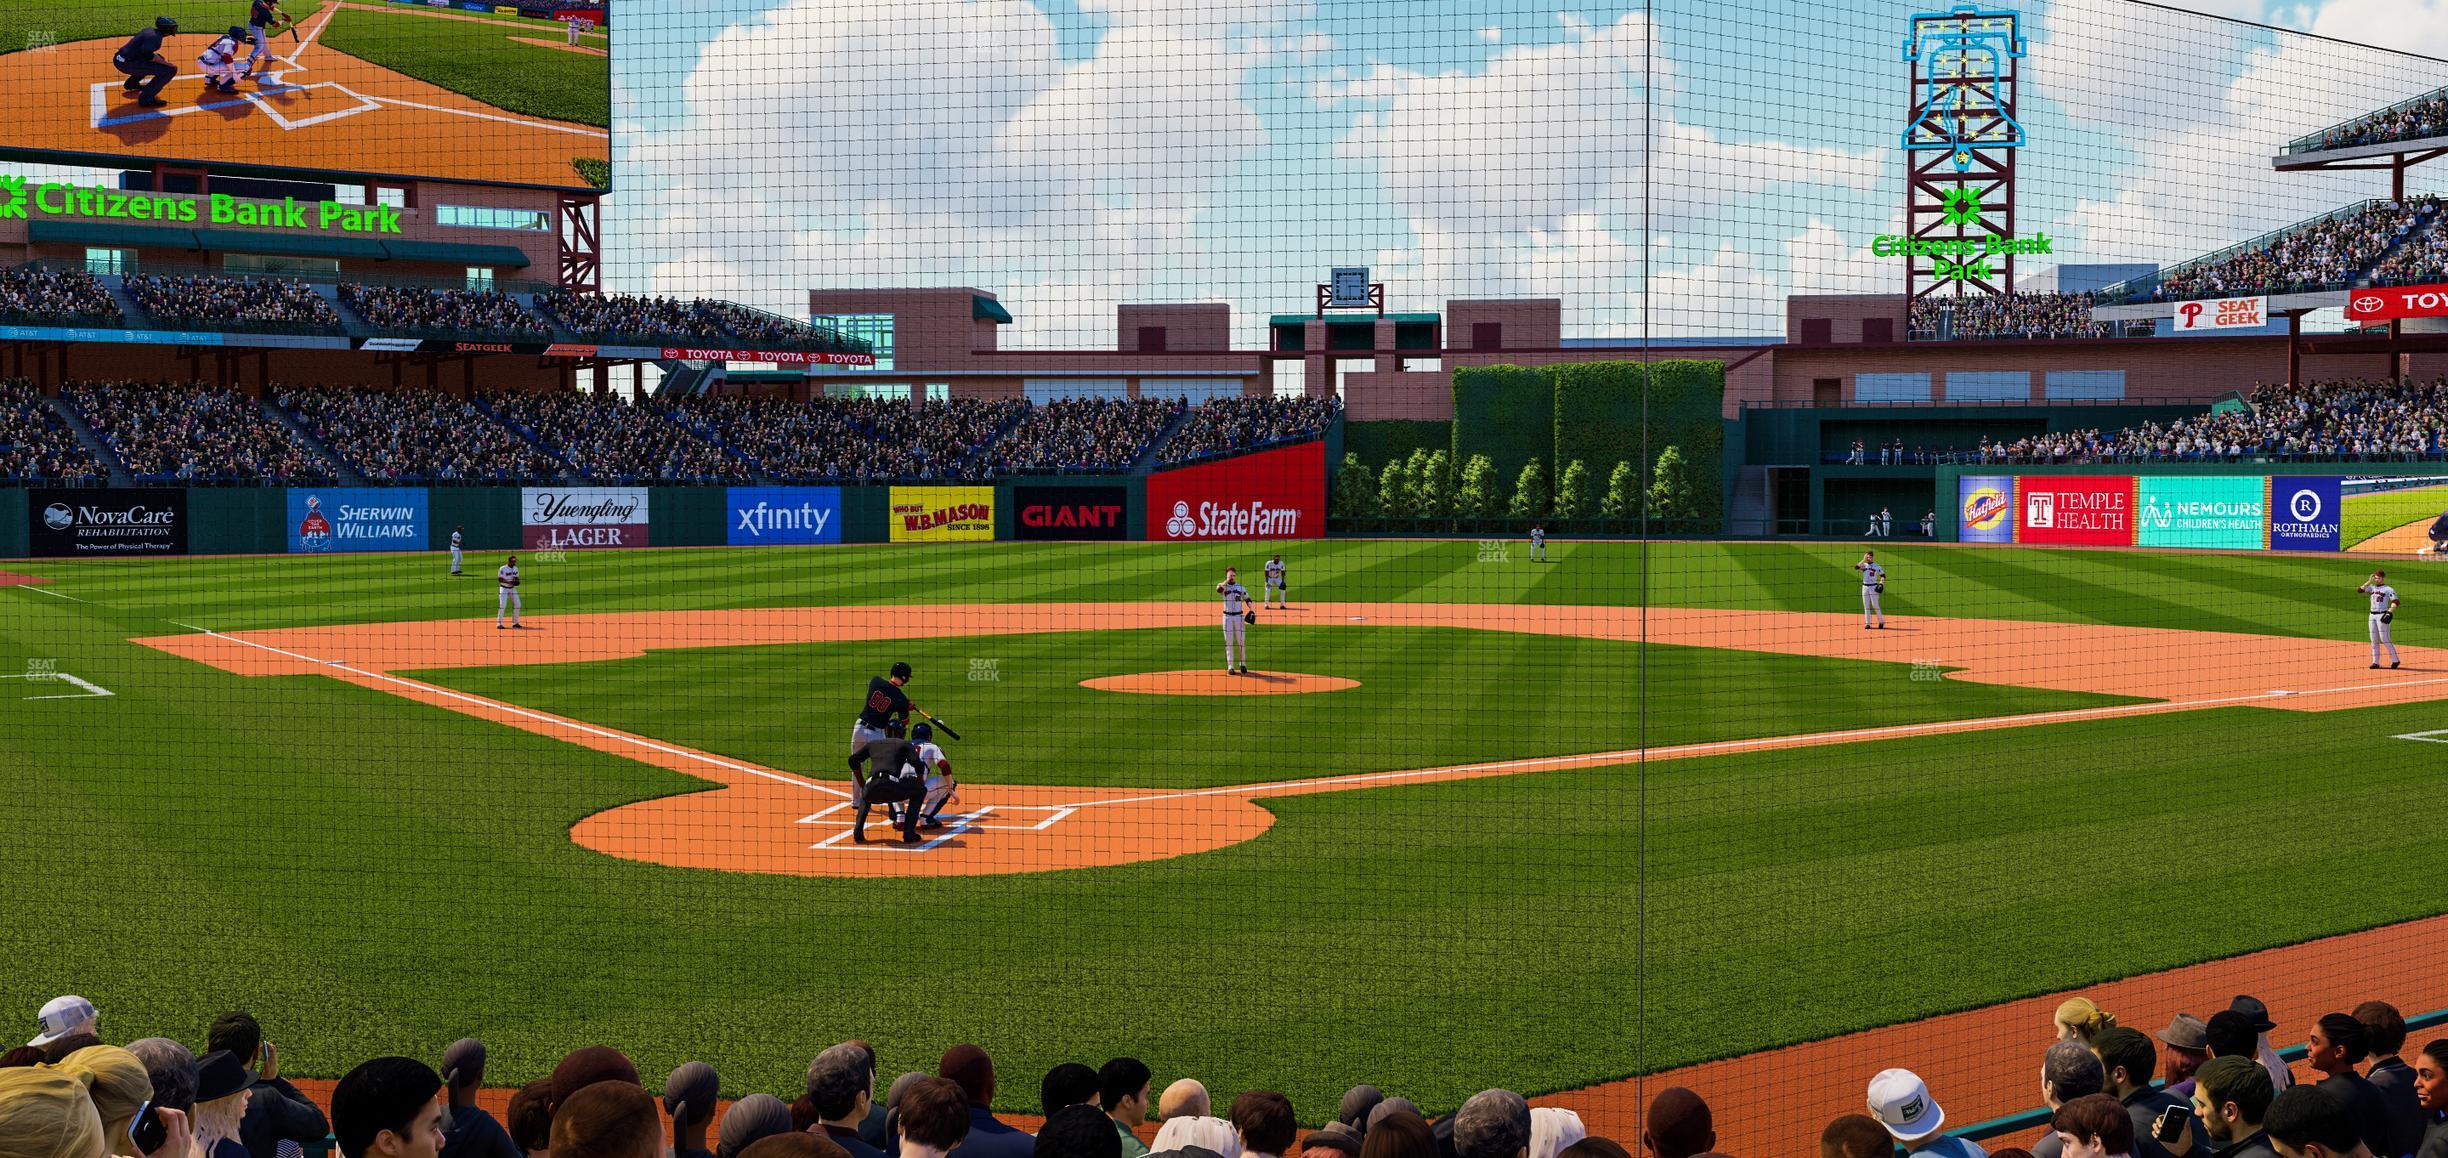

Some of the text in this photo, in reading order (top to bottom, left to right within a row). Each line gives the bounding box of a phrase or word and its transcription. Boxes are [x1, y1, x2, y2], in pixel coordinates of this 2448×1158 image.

[35, 182, 401, 233] Citizens Bank Park
[1872, 231, 2053, 257] Citizens Bank
[1934, 258, 1993, 280] Park
[2218, 298, 2259, 313] SEAT
[2215, 311, 2260, 326] GEEK
[19, 329, 39, 337] AT&T
[455, 342, 512, 353] SEATGEEK
[686, 349, 734, 360] TOYOTA
[757, 351, 804, 362] TOYOTA
[827, 354, 872, 365] TOYOTA
[533, 493, 639, 523] Yuengling
[1966, 490, 2007, 521] Hatfield
[2057, 492, 2124, 509] TEMPLE
[2300, 500, 2312, 511] R
[75, 505, 174, 525] NovaCare
[338, 505, 413, 520] SHERWIN
[893, 505, 909, 513] WHO
[1022, 505, 1121, 527] GIANT
[2177, 502, 2262, 516] NEMOURS
[738, 502, 831, 535] xfinity
[2057, 513, 2124, 530] HEALTH
[2177, 519, 2262, 530] CHILDREN'S HEALTH
[77, 528, 171, 537] REHABILITATION
[337, 523, 414, 538] WILLIAMS
[2272, 523, 2338, 533] ROTHMAN
[551, 528, 622, 546] LAGER
